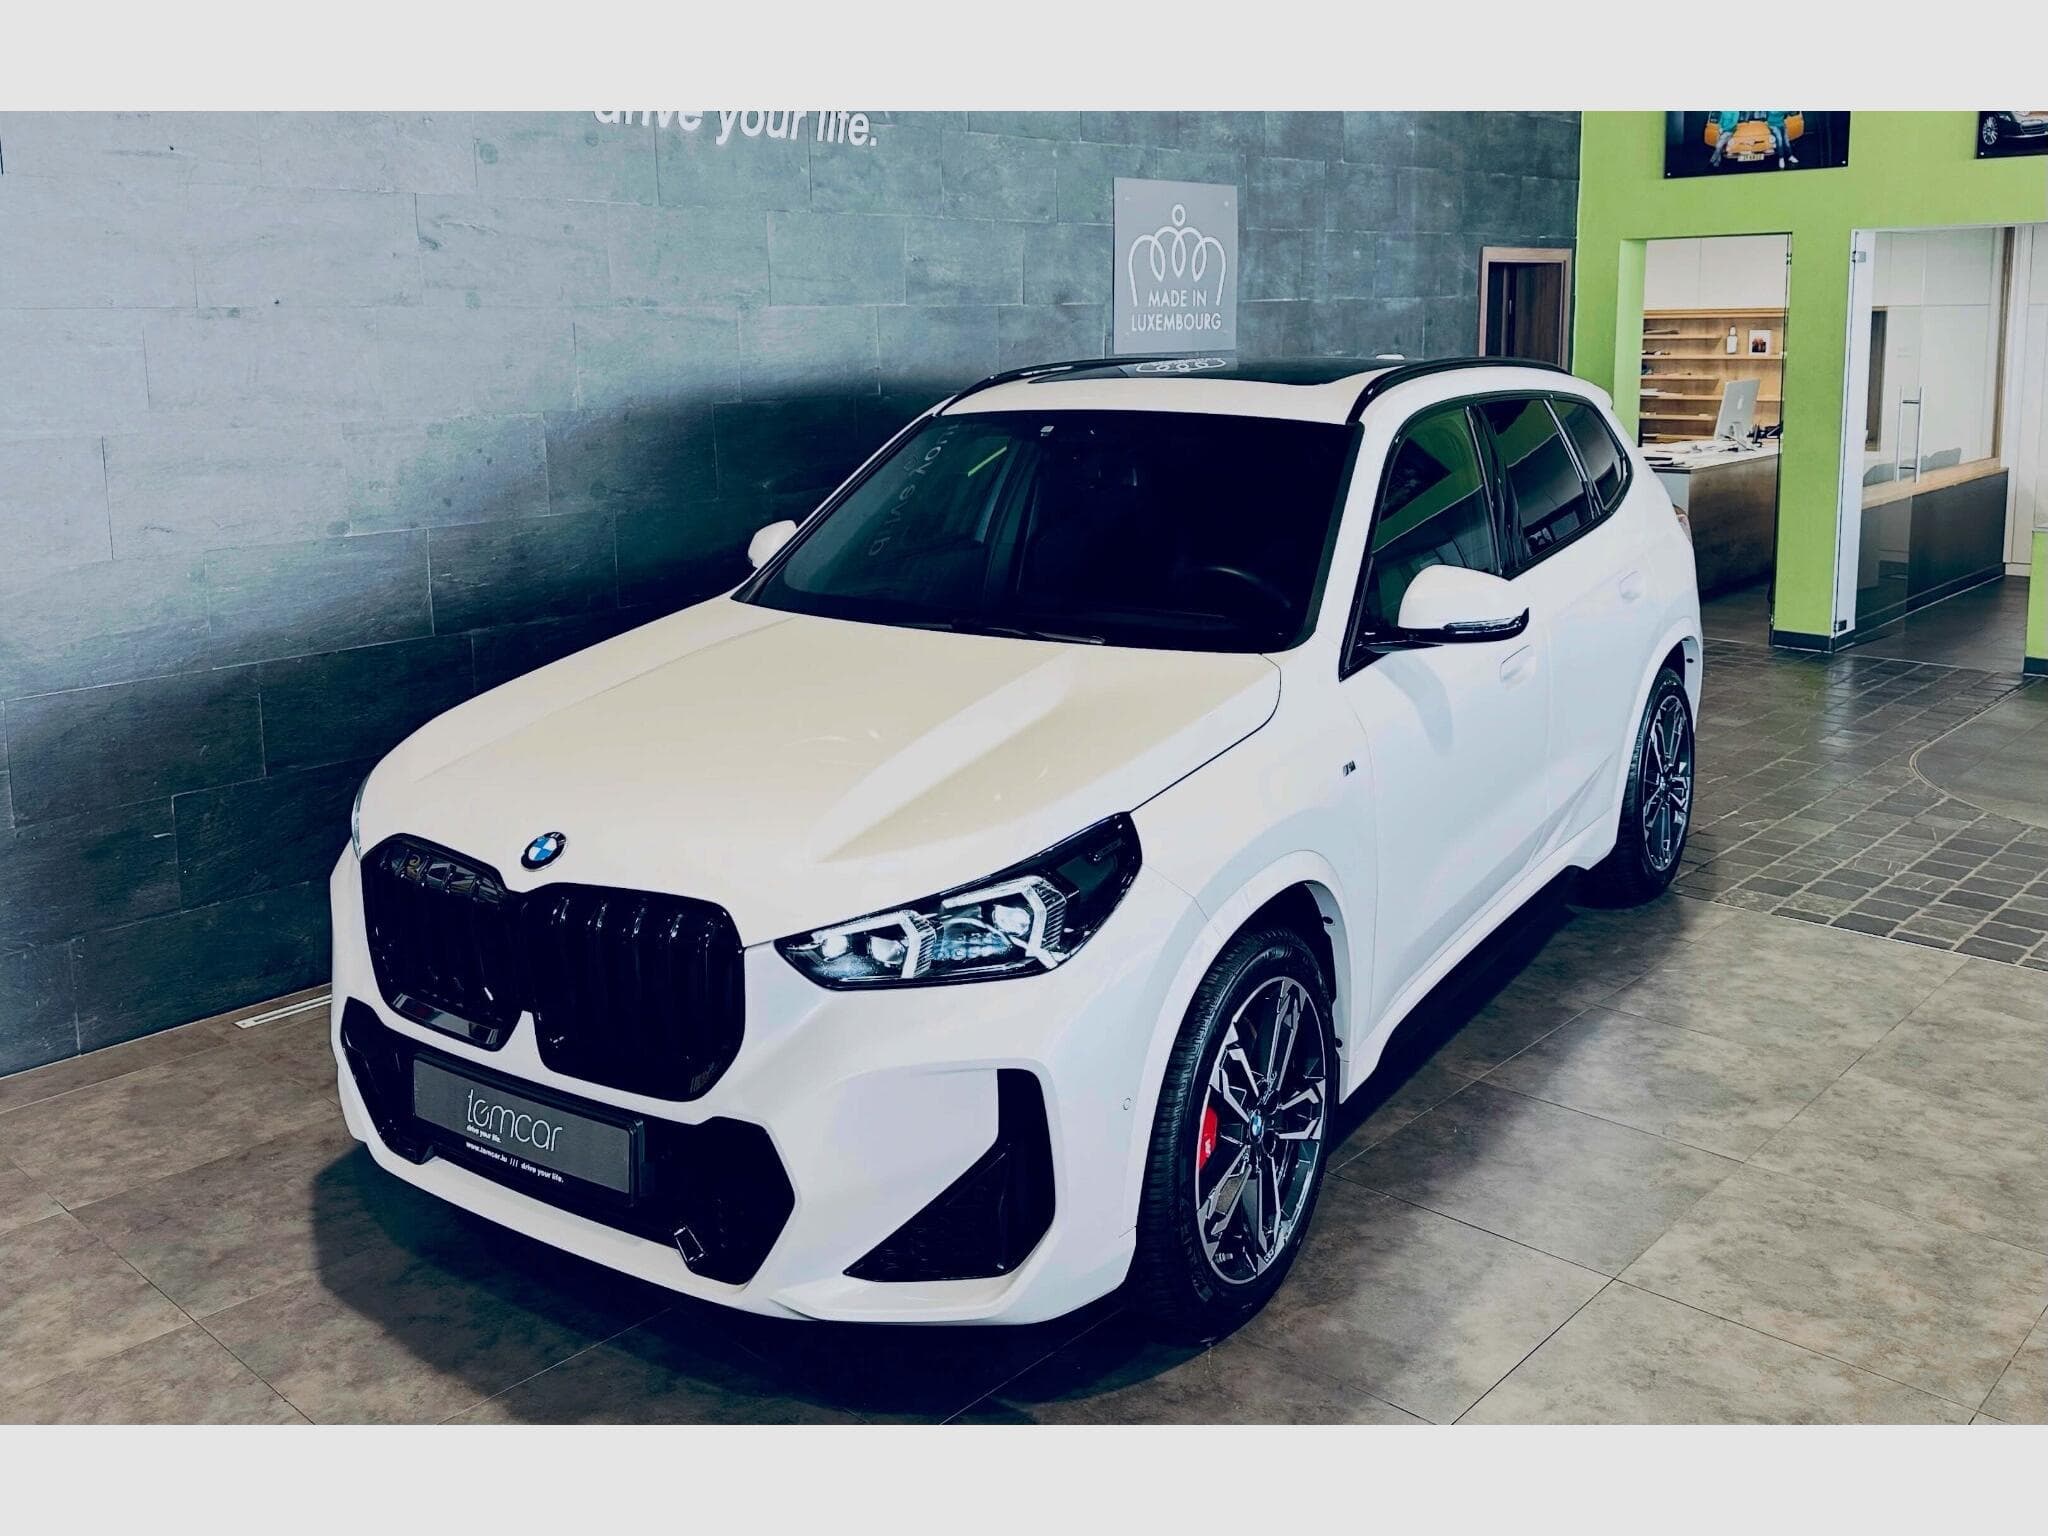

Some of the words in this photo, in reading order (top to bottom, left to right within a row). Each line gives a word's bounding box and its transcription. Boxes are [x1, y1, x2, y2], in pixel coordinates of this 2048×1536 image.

[715, 111, 807, 145] your
[1148, 289, 1187, 307] MADE
[1192, 289, 1207, 307] IN
[1131, 312, 1221, 332] LUXEMBOURG
